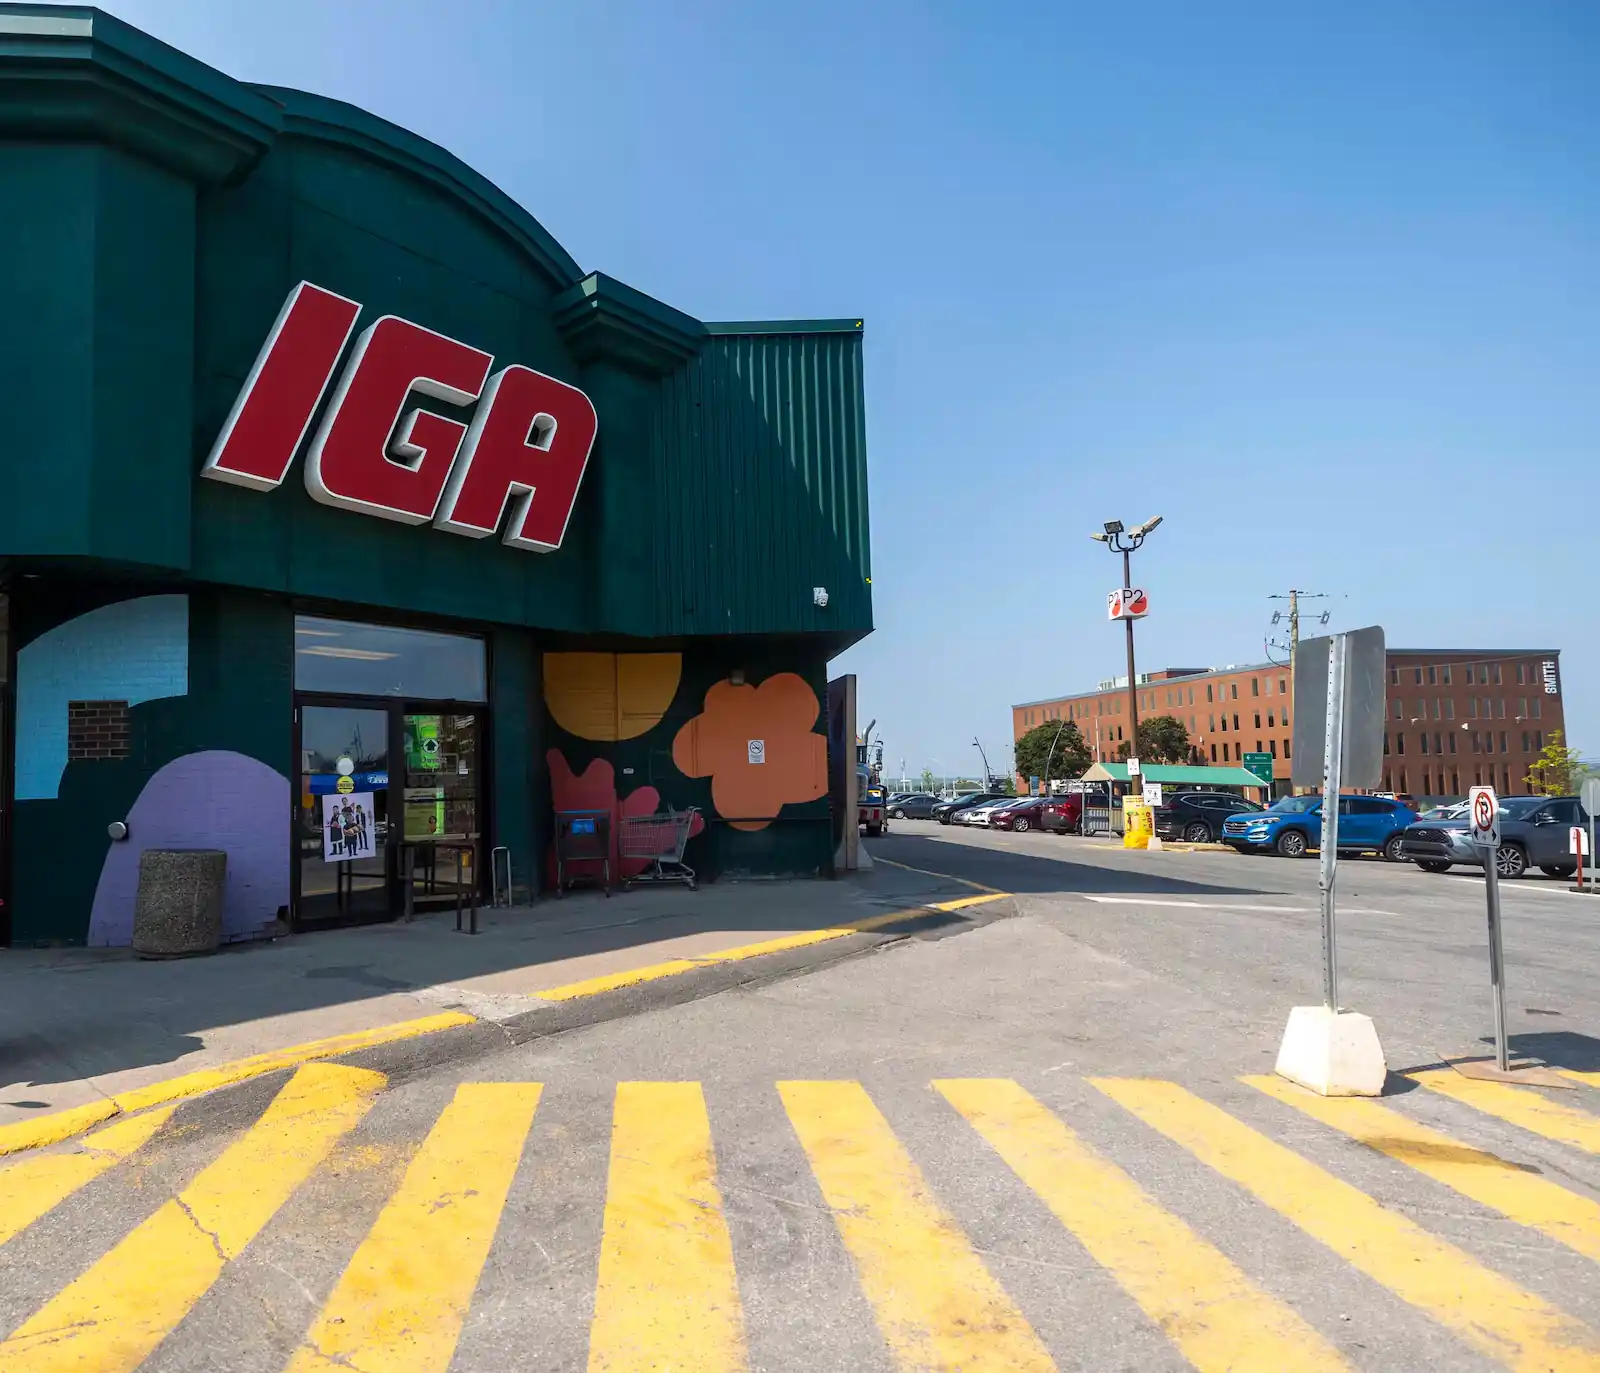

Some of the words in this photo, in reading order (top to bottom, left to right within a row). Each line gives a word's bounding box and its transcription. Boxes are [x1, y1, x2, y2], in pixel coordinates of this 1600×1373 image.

[200, 280, 598, 553] IGA
[1108, 592, 1121, 608] P2
[1123, 589, 1144, 604] P2
[1542, 661, 1557, 694] SMITH
